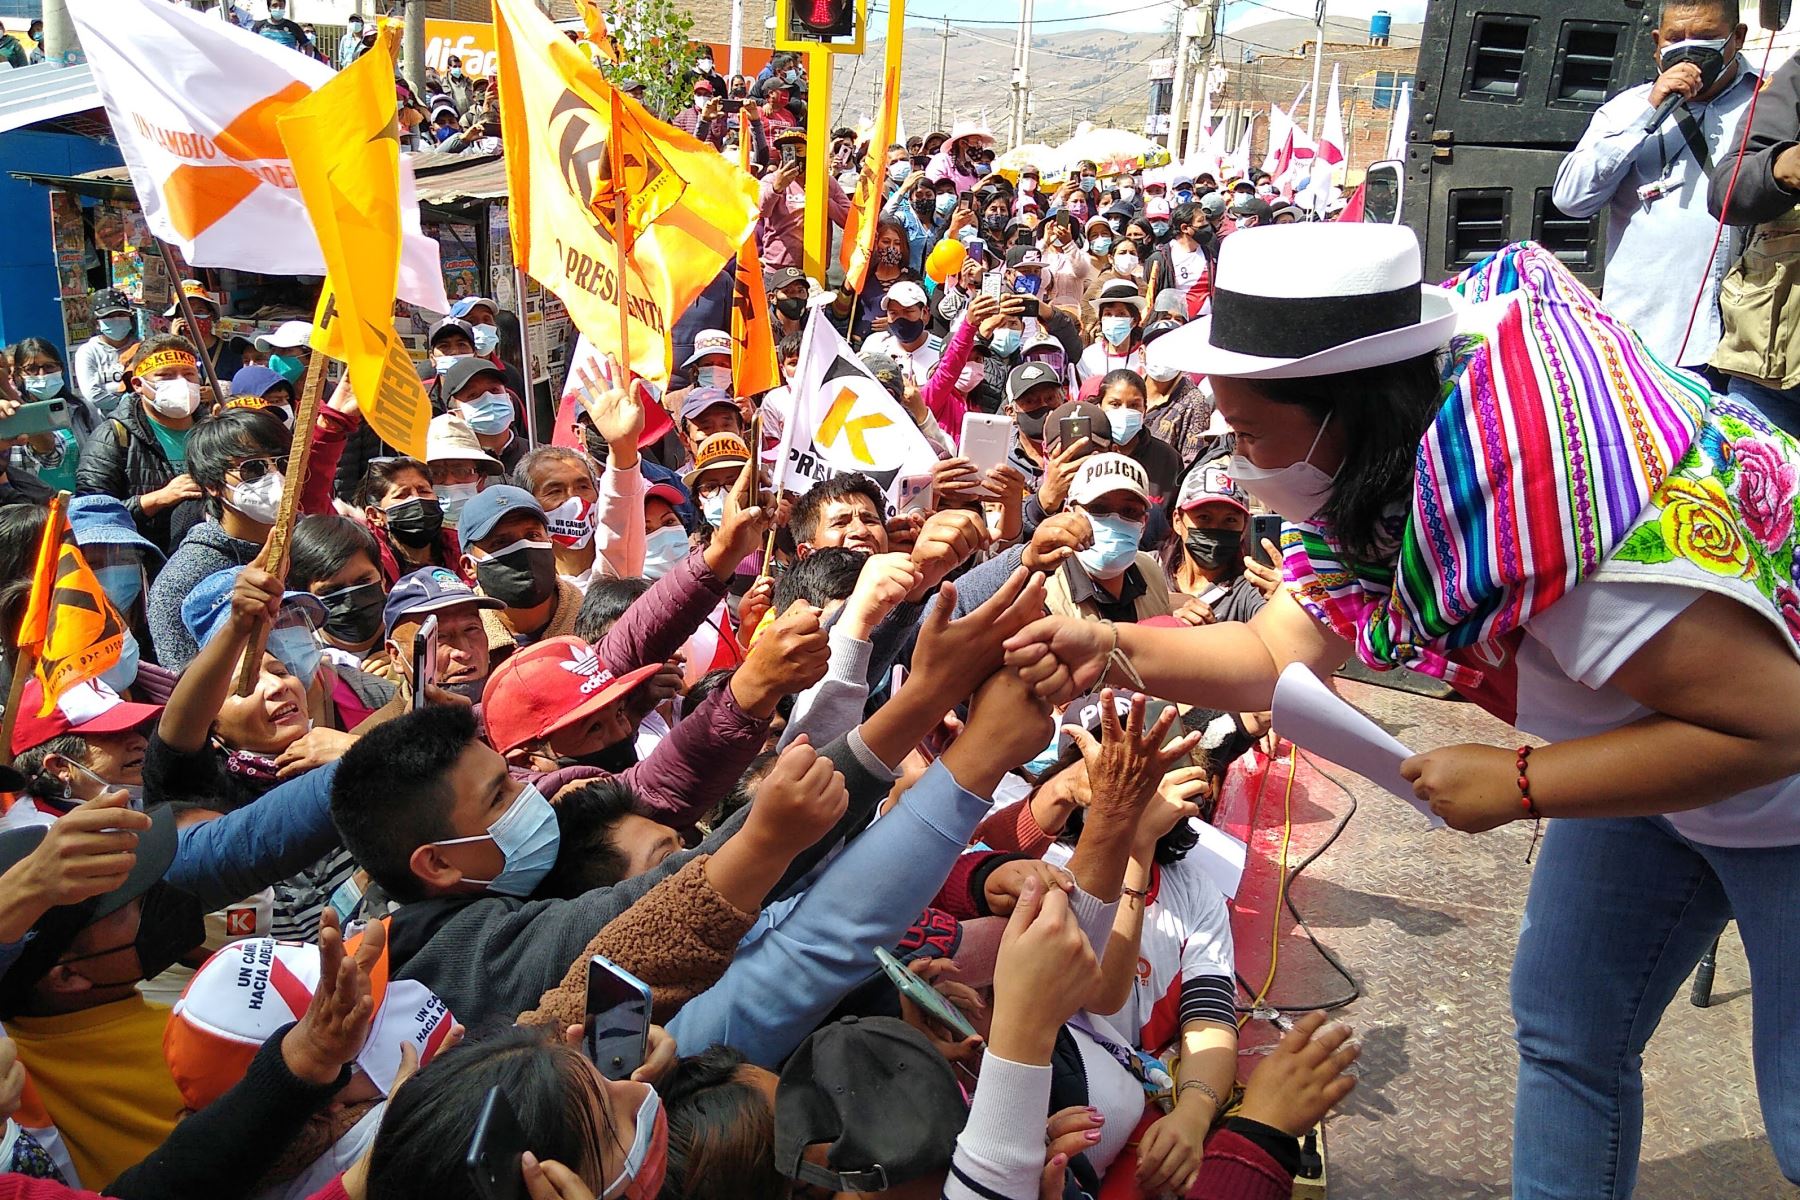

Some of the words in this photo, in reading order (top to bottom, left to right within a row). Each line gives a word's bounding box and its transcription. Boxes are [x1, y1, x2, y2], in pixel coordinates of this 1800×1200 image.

[1086, 460, 1145, 490] POLICIA
[580, 669, 613, 694] adidas
[237, 967, 254, 988] UN
[248, 969, 269, 1010] HACIA
[415, 1007, 430, 1023] UN
[415, 1014, 440, 1044] HACIA
